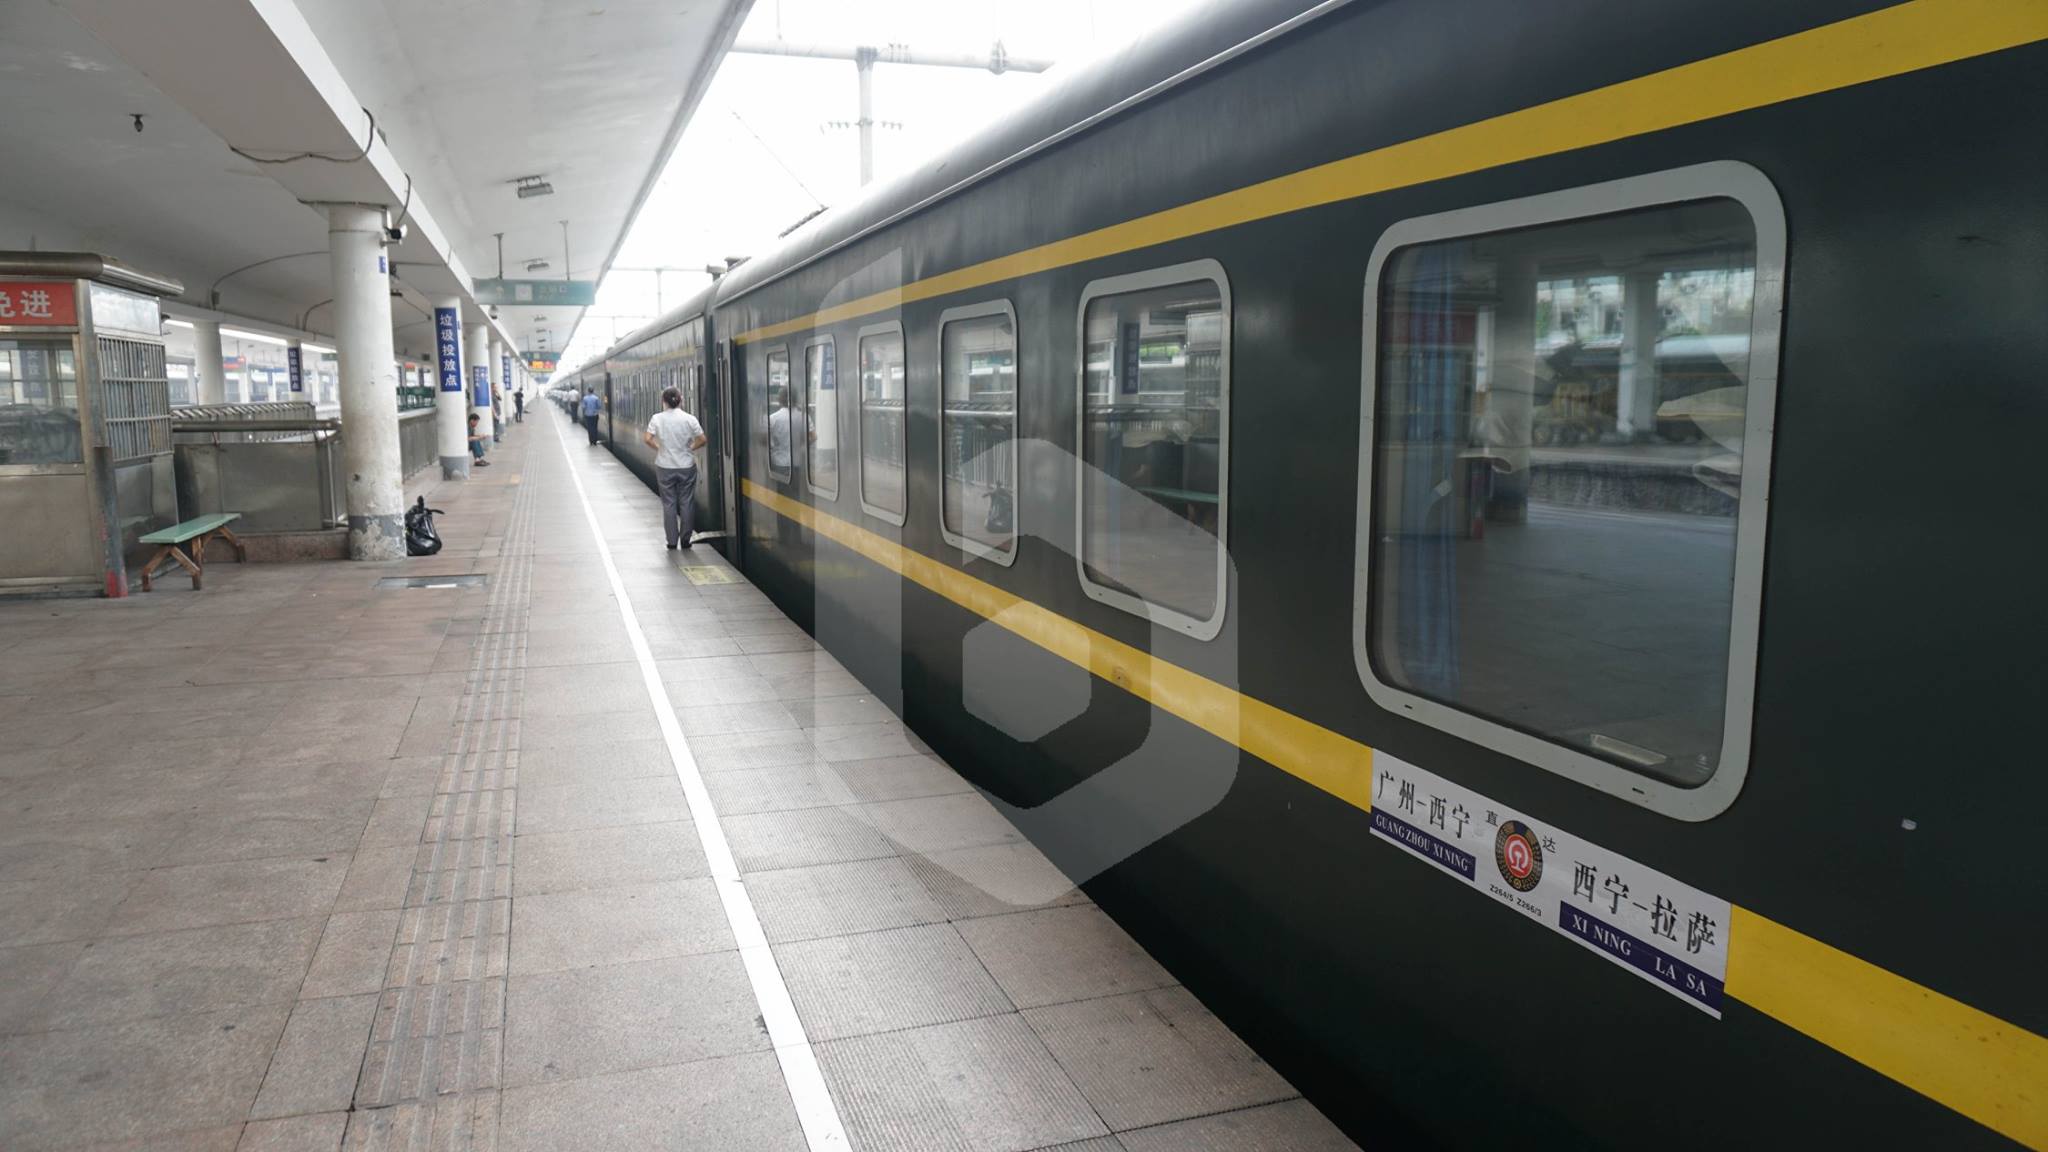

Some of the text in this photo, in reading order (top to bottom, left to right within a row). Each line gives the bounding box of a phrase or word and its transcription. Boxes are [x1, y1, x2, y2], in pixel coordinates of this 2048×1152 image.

[439, 313, 458, 387] 垃圾投放点
[1594, 925, 1632, 956] NING
[1655, 956, 1677, 981] LA
[1686, 973, 1707, 997] SA
